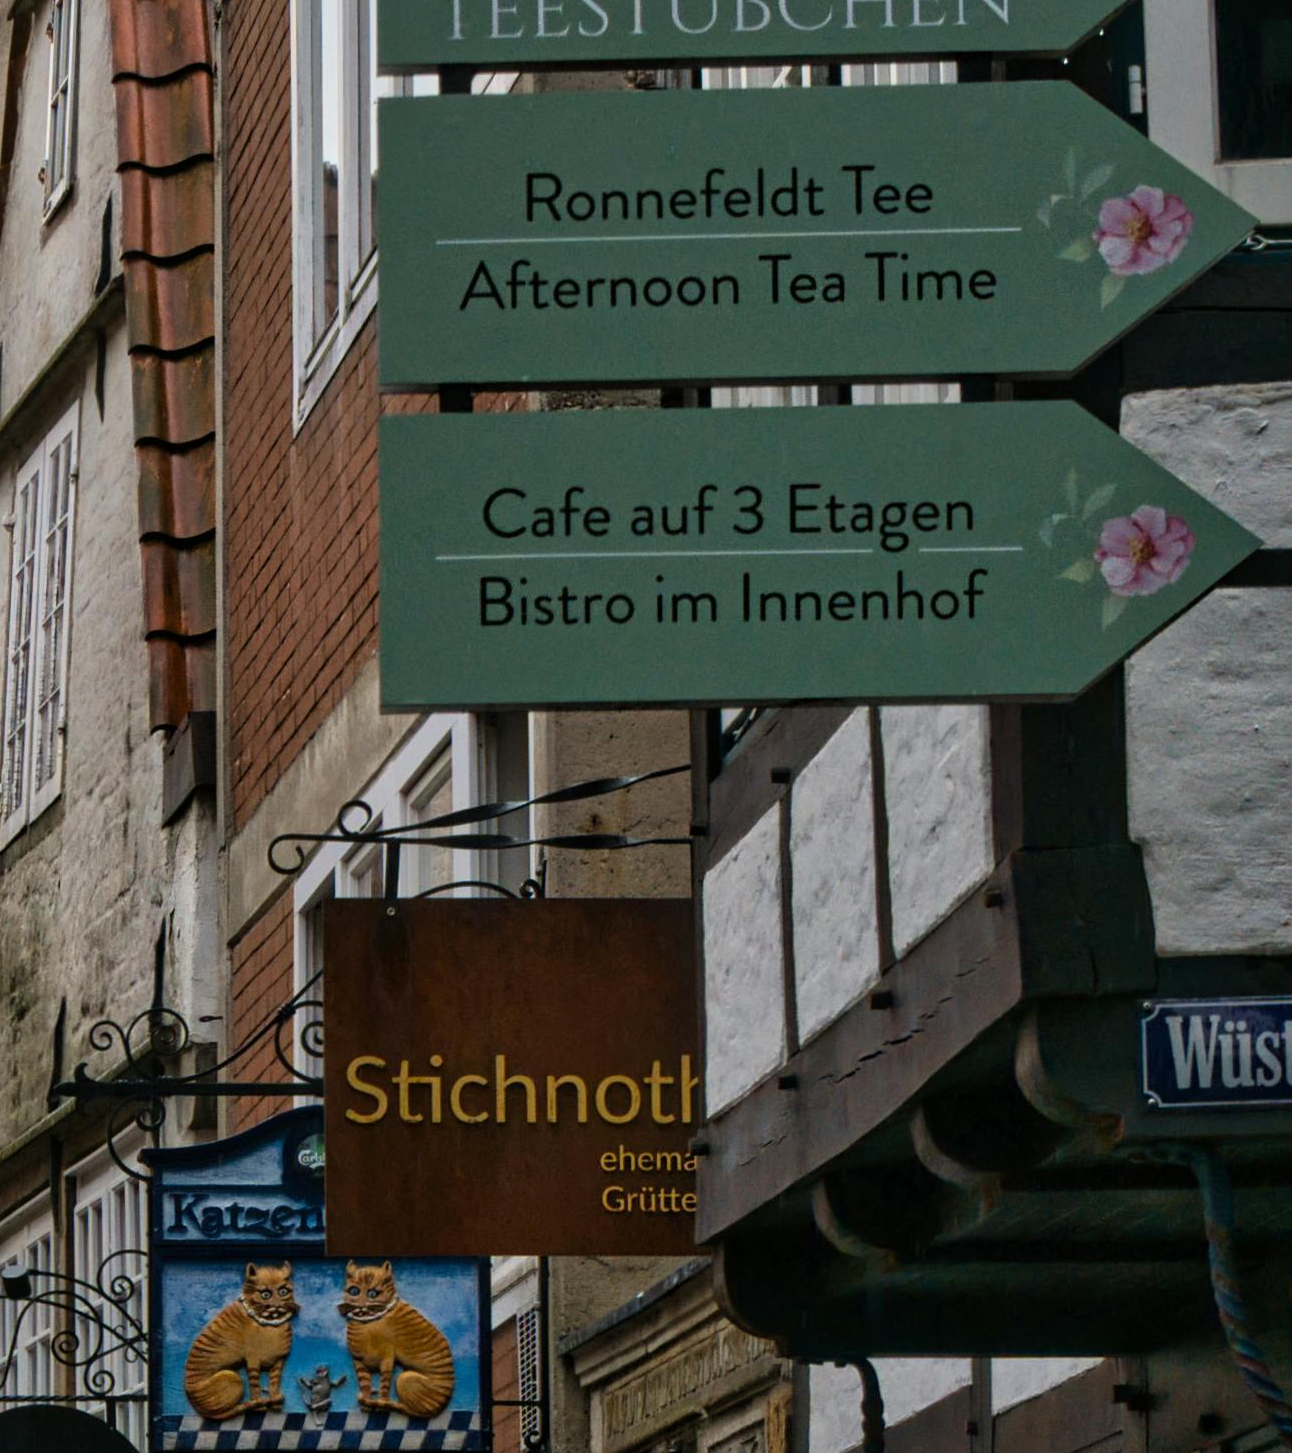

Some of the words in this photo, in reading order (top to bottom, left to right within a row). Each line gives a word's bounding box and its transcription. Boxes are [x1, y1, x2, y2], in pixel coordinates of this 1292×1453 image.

[524, 167, 827, 224] Ronnefeldt
[842, 164, 935, 216] Tee
[459, 259, 741, 312] Afternoon
[758, 253, 847, 305] Tea
[864, 250, 999, 302] Time
[481, 486, 612, 540] Cafe
[629, 485, 718, 538] auf
[732, 485, 765, 536] 3
[788, 483, 976, 550] Etagen
[478, 575, 637, 628] Bistro
[654, 575, 720, 623] im
[742, 569, 987, 622] Innenhof
